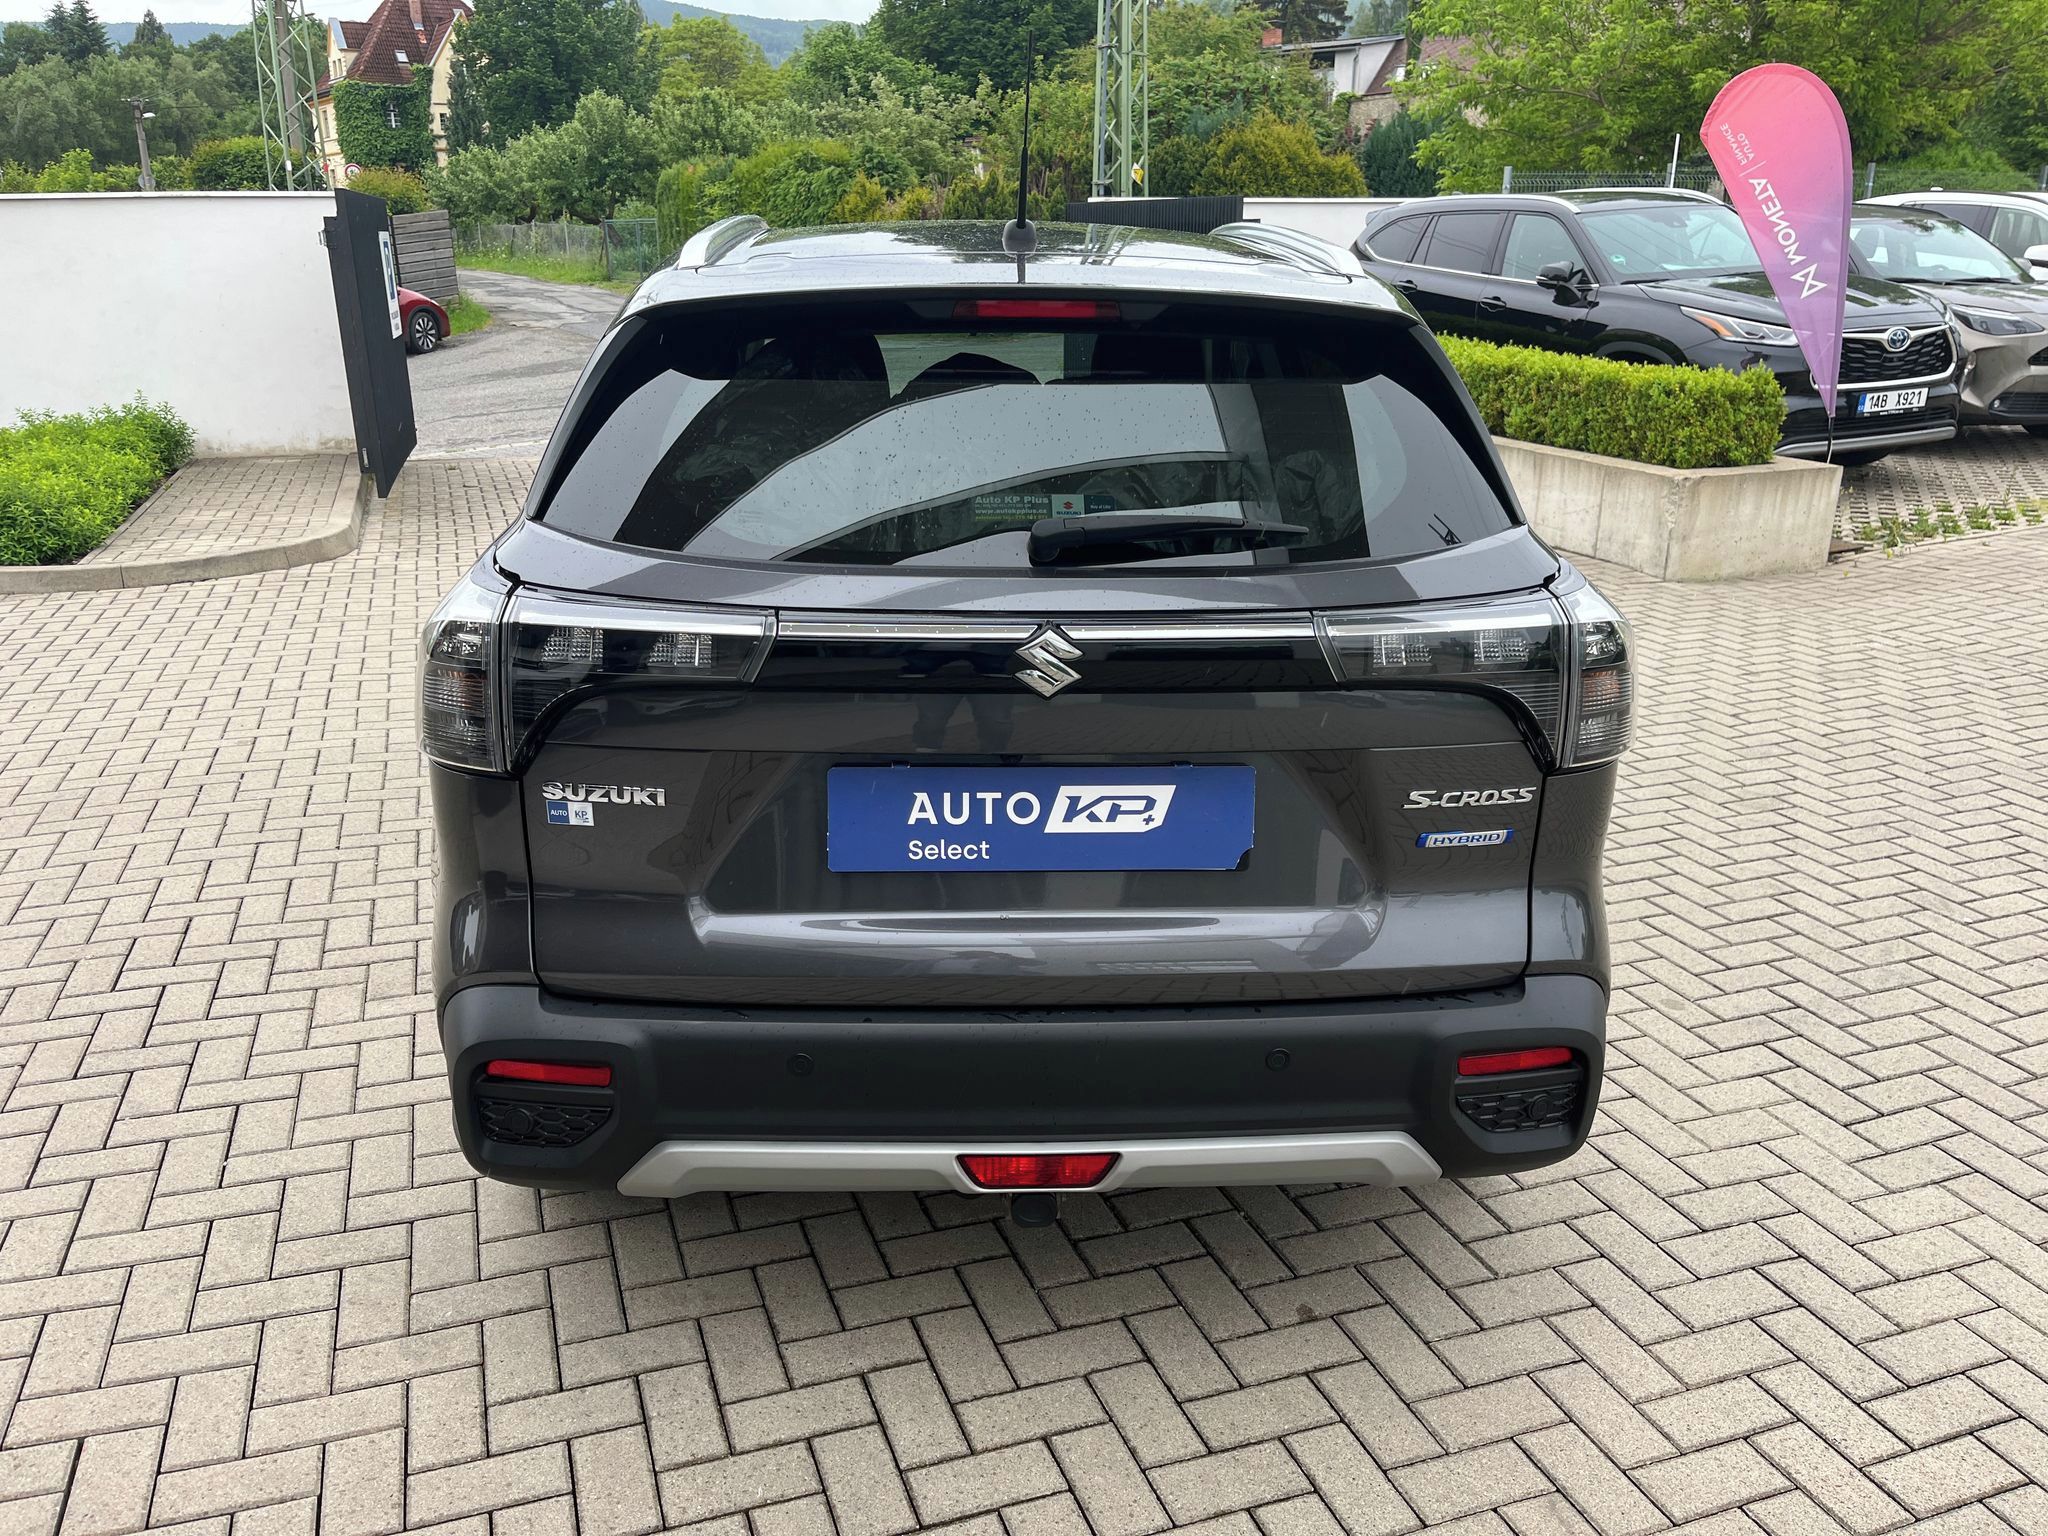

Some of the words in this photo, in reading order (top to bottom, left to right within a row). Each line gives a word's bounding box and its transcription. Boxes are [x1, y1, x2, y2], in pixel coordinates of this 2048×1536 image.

[1868, 394, 1888, 410] 1AB
[1895, 390, 1922, 407] X921
[975, 495, 1001, 504] Auto
[1004, 495, 1020, 504] KP
[1023, 495, 1049, 504] Plus
[542, 781, 666, 806] SUZUKI
[1402, 786, 1537, 809] S-CROSS
[550, 809, 568, 817] AUTO
[907, 791, 1041, 826] AUTO
[908, 839, 990, 860] Select
[1432, 833, 1501, 846] HYBRID
